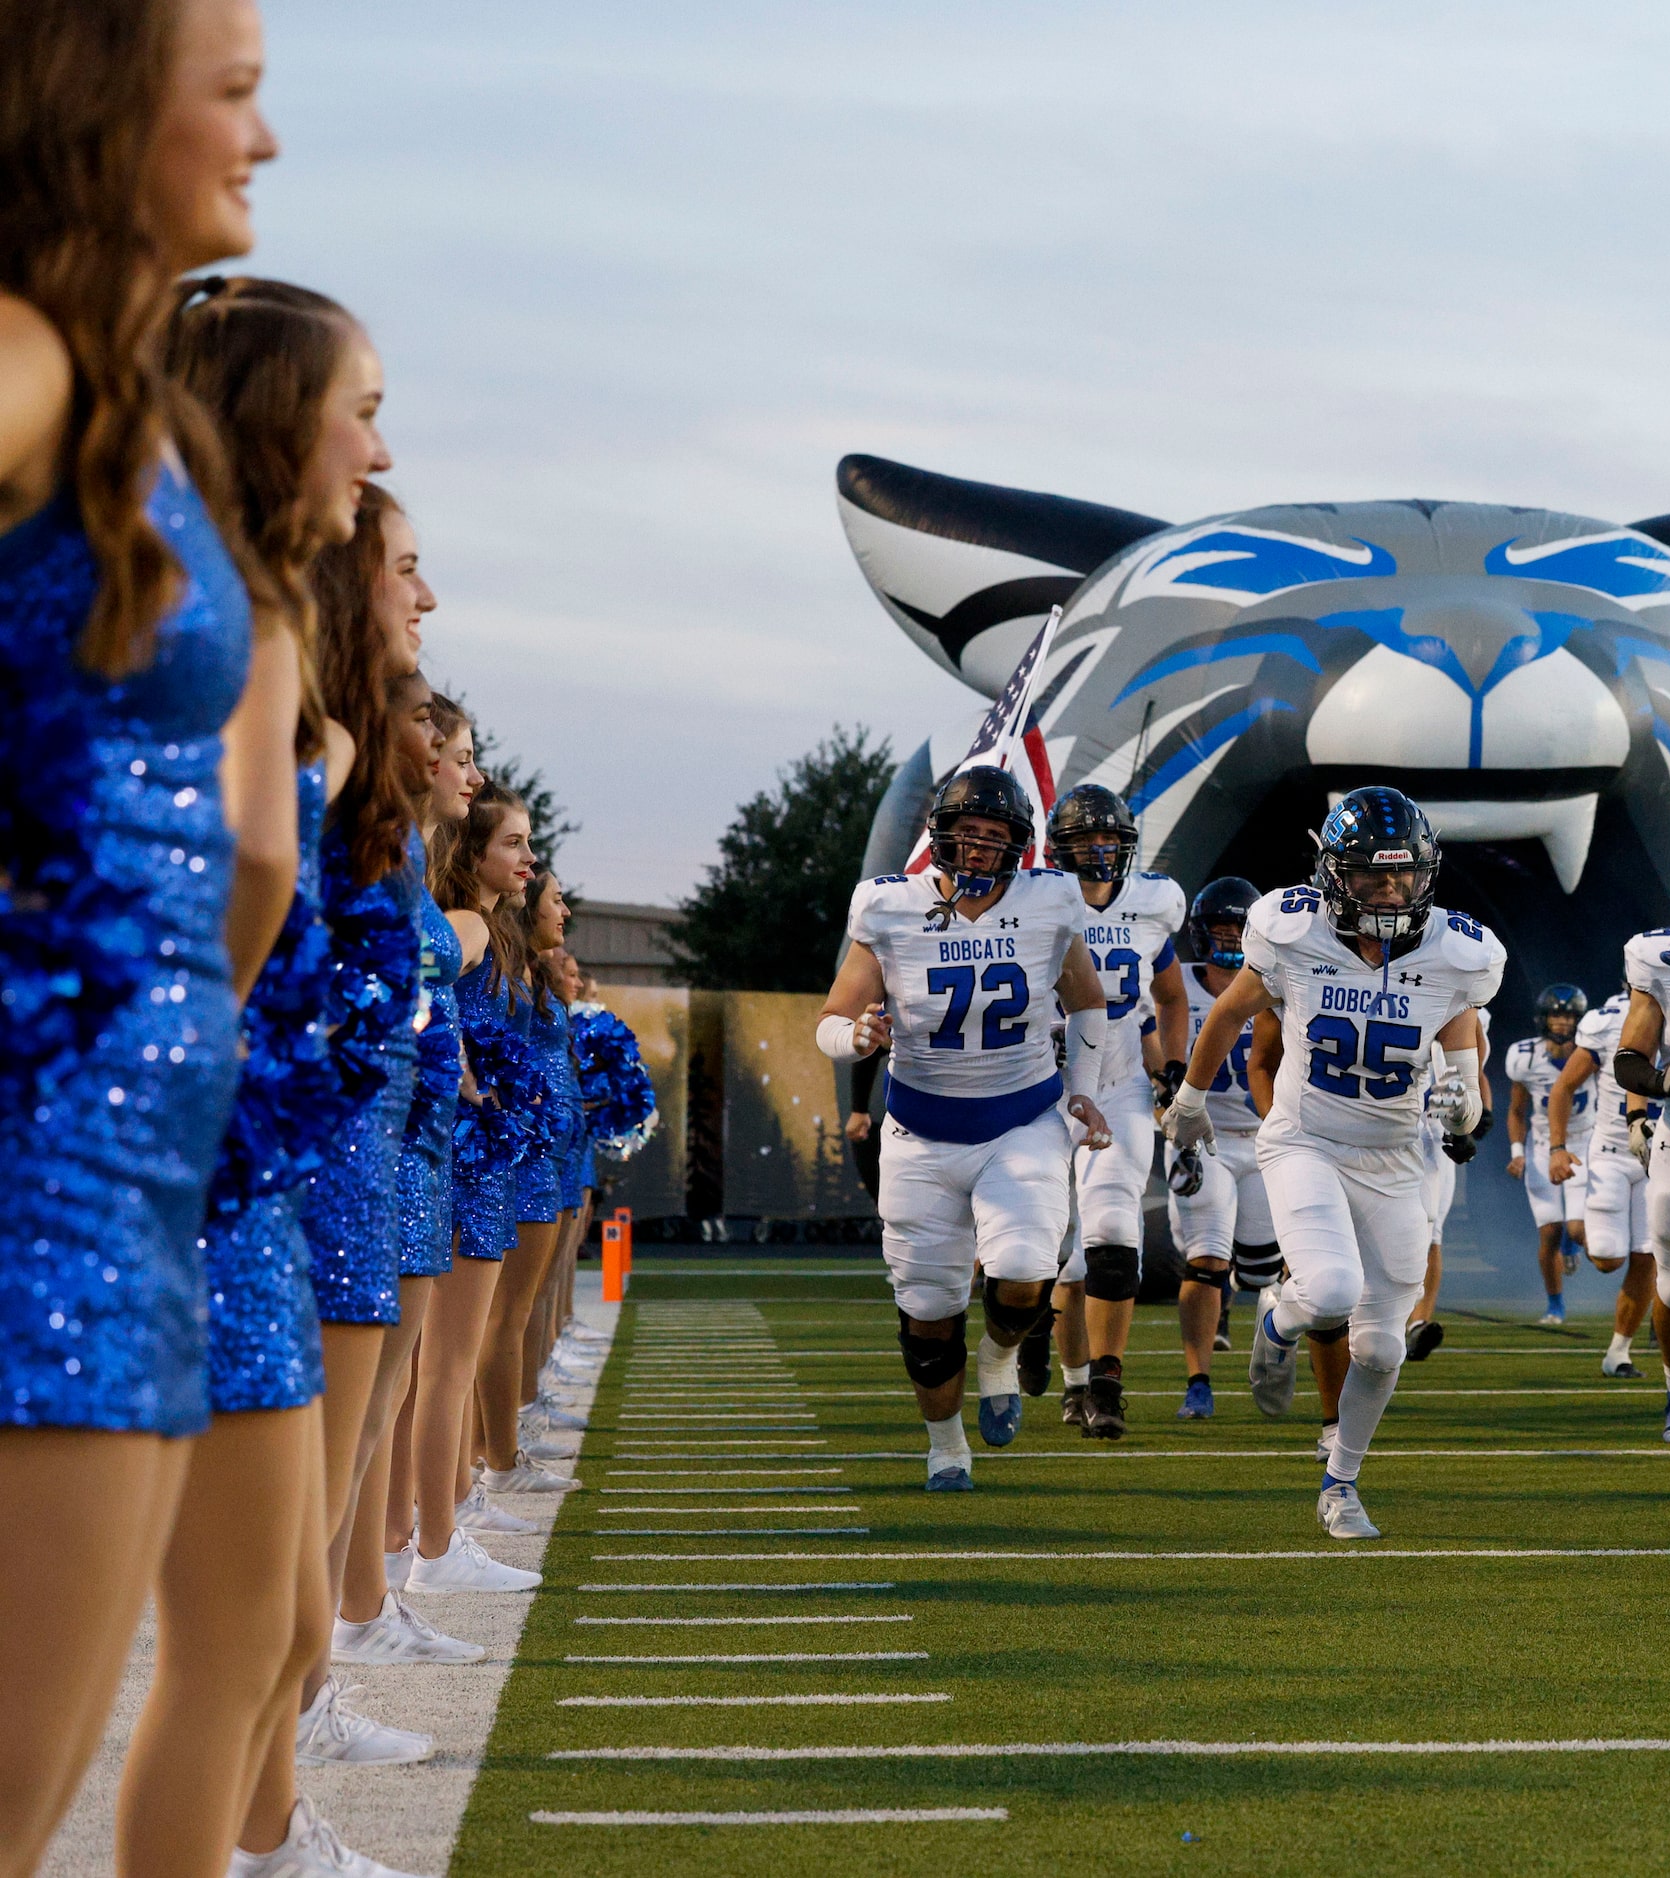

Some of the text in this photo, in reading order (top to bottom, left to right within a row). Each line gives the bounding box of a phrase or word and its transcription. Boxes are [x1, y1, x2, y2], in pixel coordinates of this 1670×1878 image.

[1378, 851, 1409, 860] Riddell
[1280, 886, 1322, 915] 25
[938, 937, 1016, 963] BOBCATS
[926, 962, 1030, 1051] 72
[1306, 1013, 1422, 1101] 25
